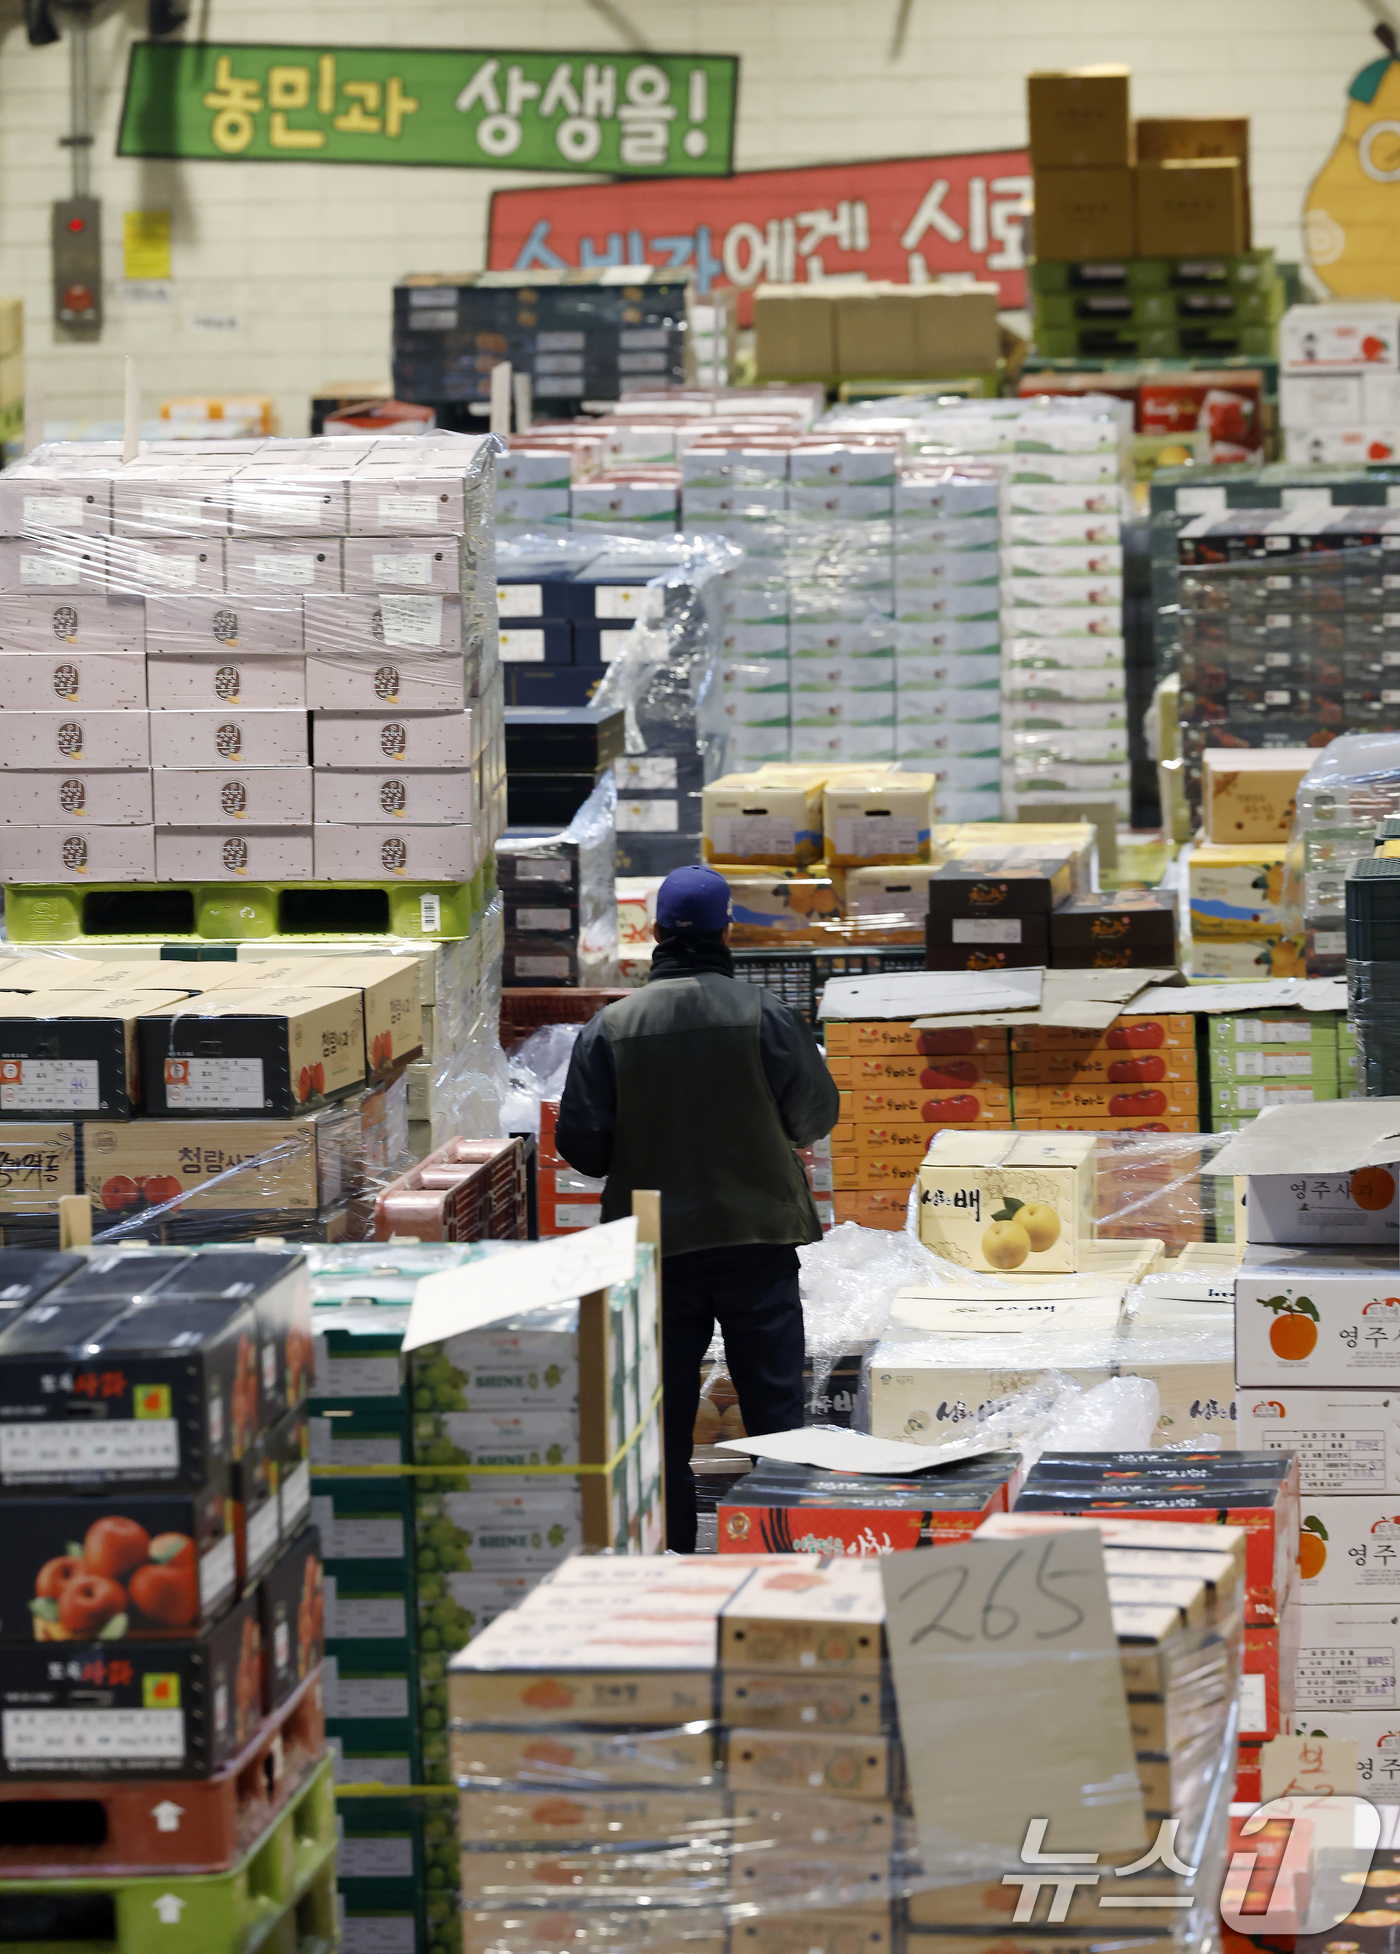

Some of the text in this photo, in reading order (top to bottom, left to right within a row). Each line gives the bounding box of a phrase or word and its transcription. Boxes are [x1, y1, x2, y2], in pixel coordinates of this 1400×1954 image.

[203, 54, 709, 166] 농민과 상생을!
[1290, 1180, 1376, 1200] 영주사과
[1340, 1326, 1400, 1348] 영주
[475, 1374, 523, 1389] SHINE
[479, 1535, 527, 1548] SHINE
[901, 1539, 1095, 1644] 265
